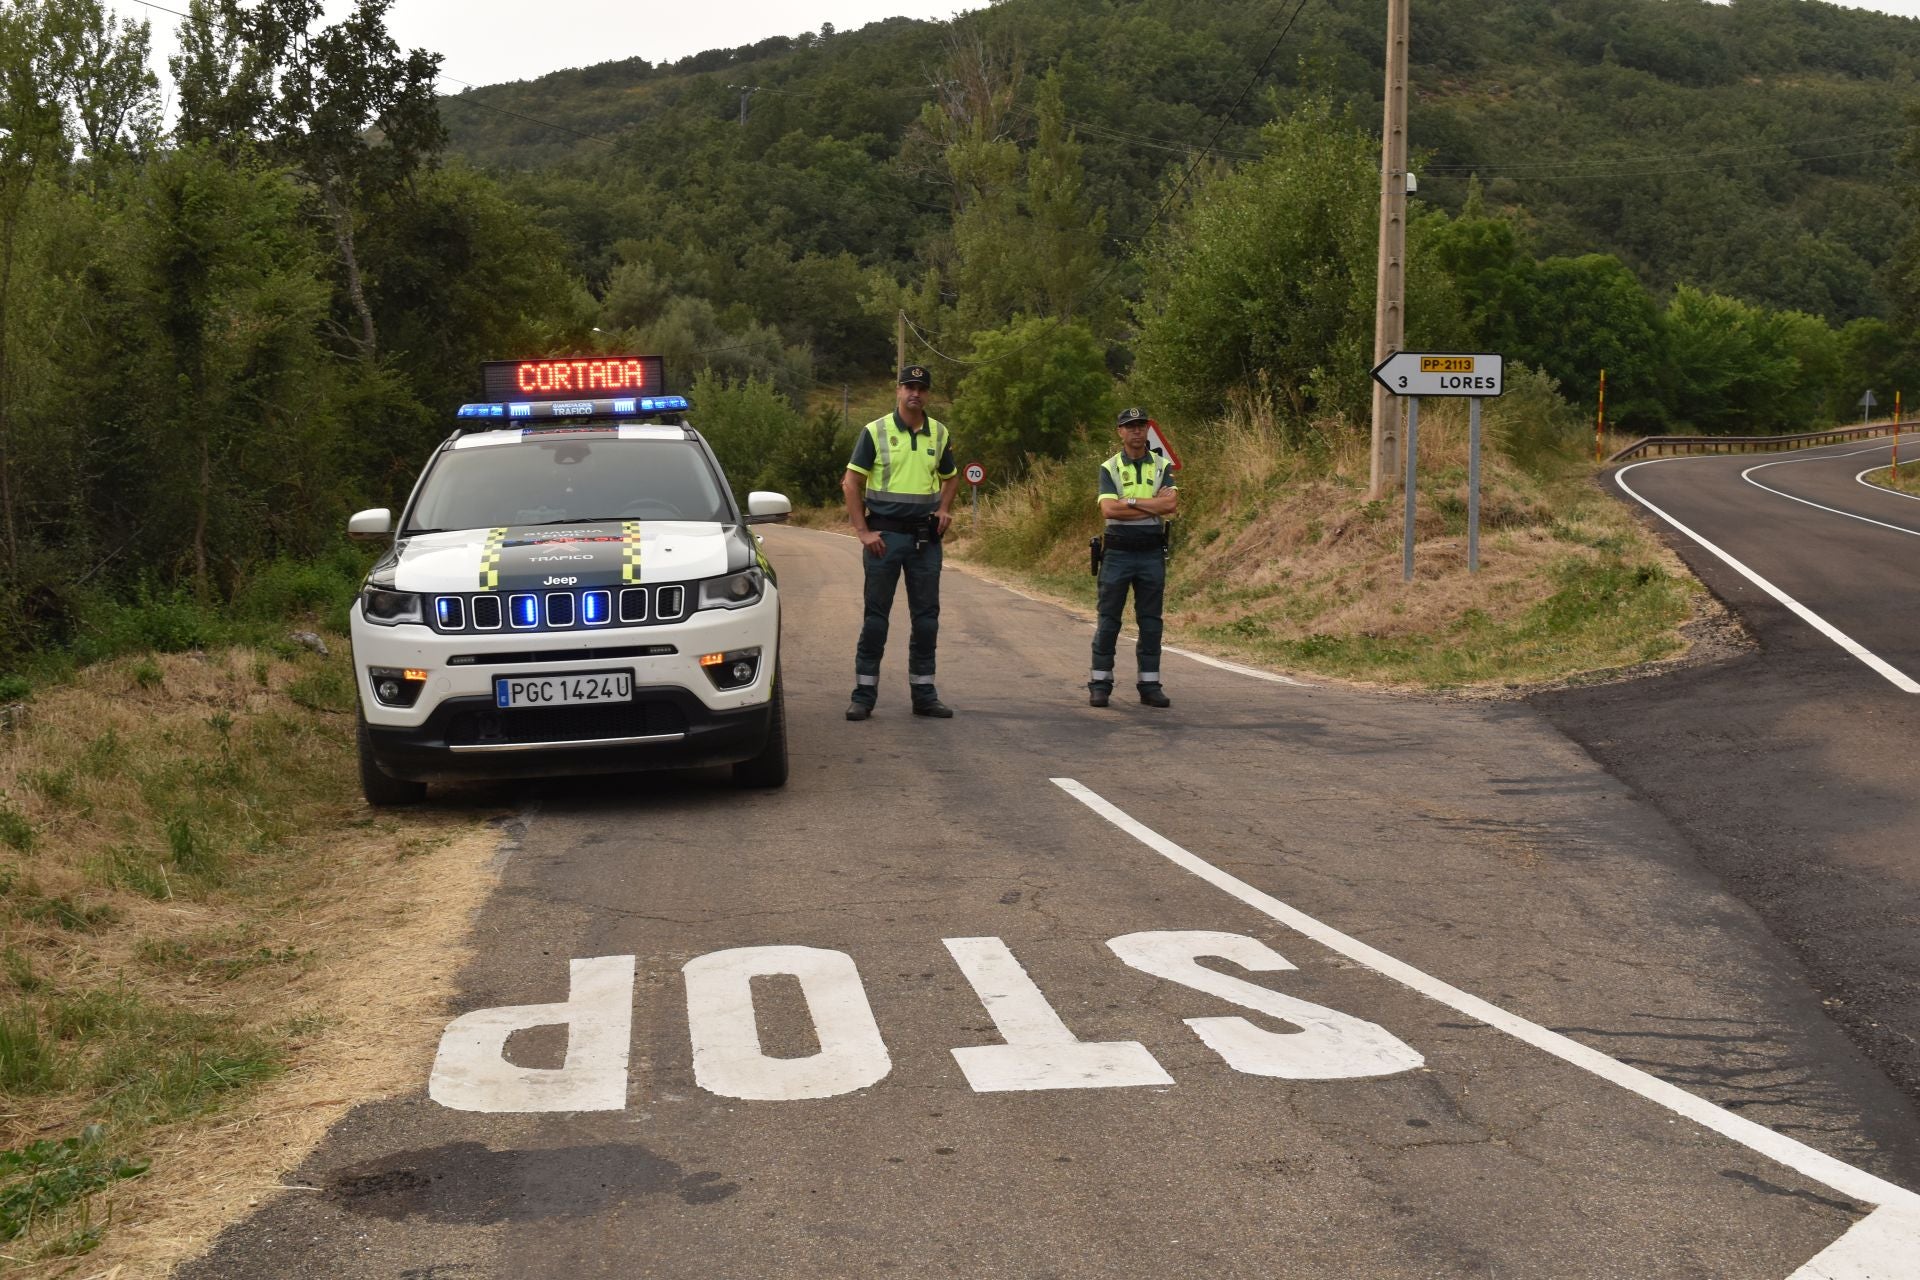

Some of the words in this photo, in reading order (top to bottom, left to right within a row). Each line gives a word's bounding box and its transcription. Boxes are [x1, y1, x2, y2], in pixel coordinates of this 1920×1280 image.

[1423, 359, 1471, 370] PP-2113
[518, 361, 642, 391] CORTADA
[1398, 376, 1408, 389] 3
[1440, 376, 1496, 389] LORES
[552, 407, 593, 416] TRAFICO
[969, 470, 981, 479] 70
[528, 554, 594, 562] TRAFICO
[543, 576, 578, 586] Jeep
[429, 930, 1425, 1112] STOP
